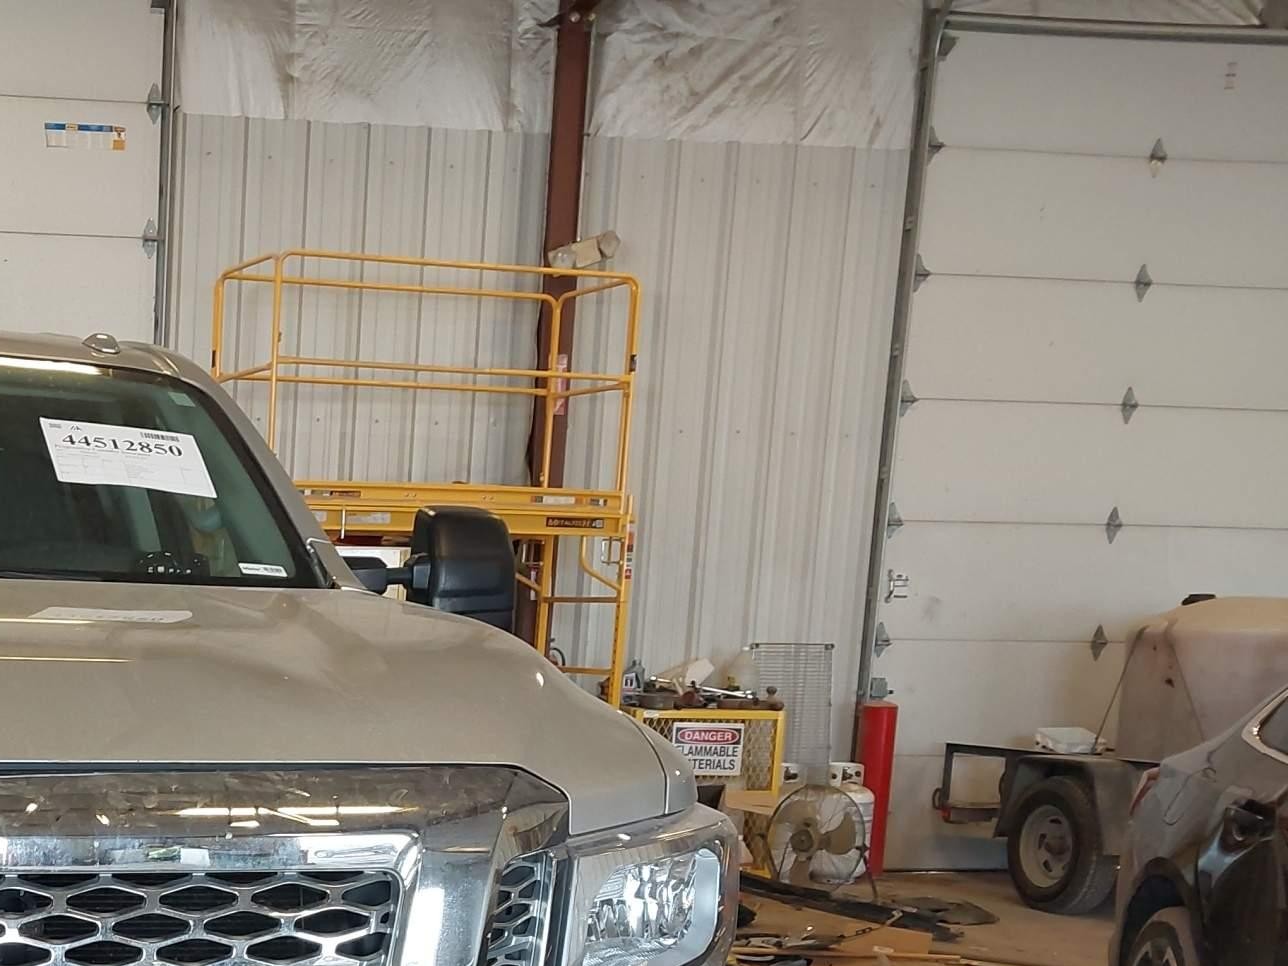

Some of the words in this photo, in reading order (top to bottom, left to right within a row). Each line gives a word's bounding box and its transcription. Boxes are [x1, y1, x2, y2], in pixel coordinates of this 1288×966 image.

[62, 434, 183, 457] 44512850
[684, 731, 732, 741] DANGER
[688, 758, 735, 770] TERIALS
